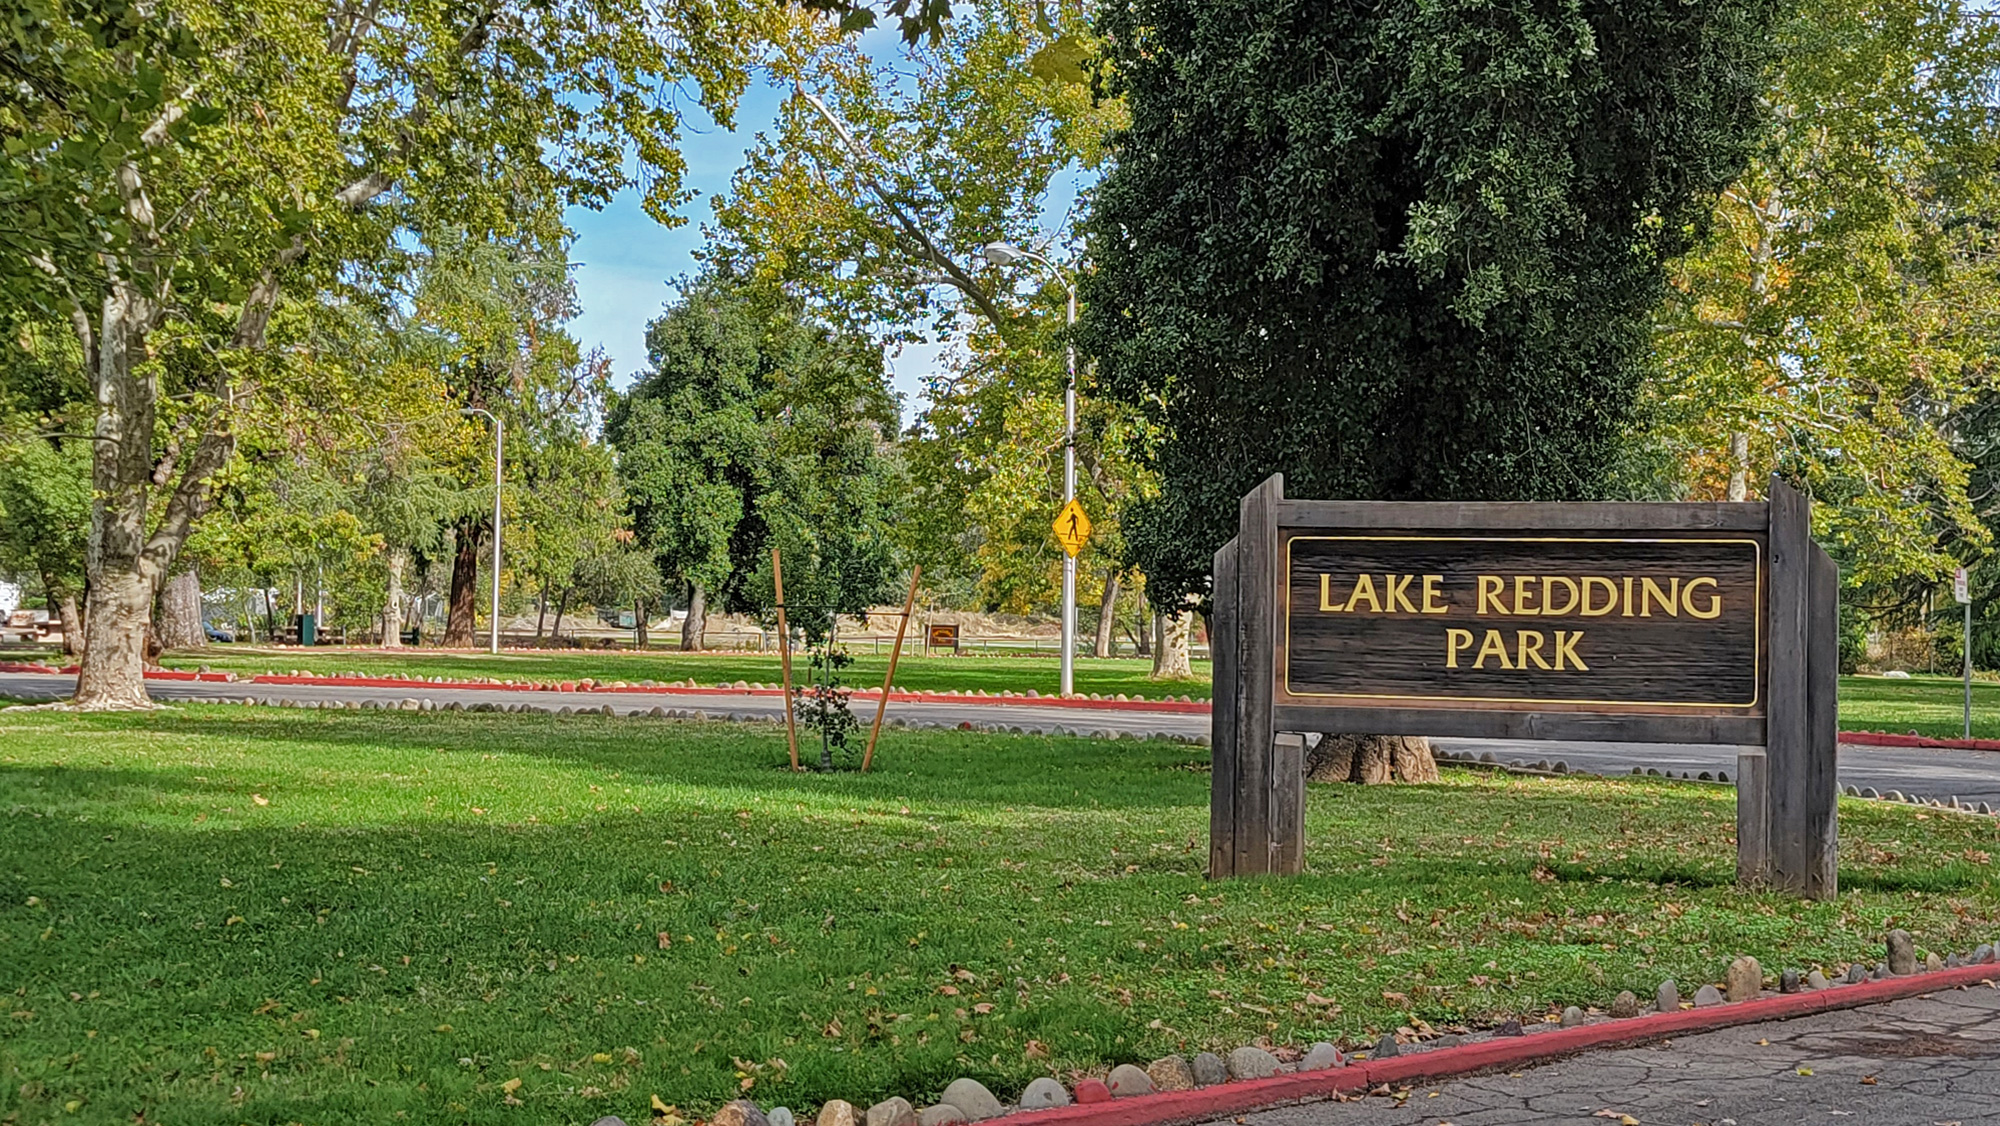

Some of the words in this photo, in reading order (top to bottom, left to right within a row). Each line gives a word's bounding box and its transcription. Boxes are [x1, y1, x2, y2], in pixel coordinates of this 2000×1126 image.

[1319, 573, 1448, 613] LAKE
[1476, 575, 1721, 619] REDDING
[1446, 628, 1588, 671] PARK
